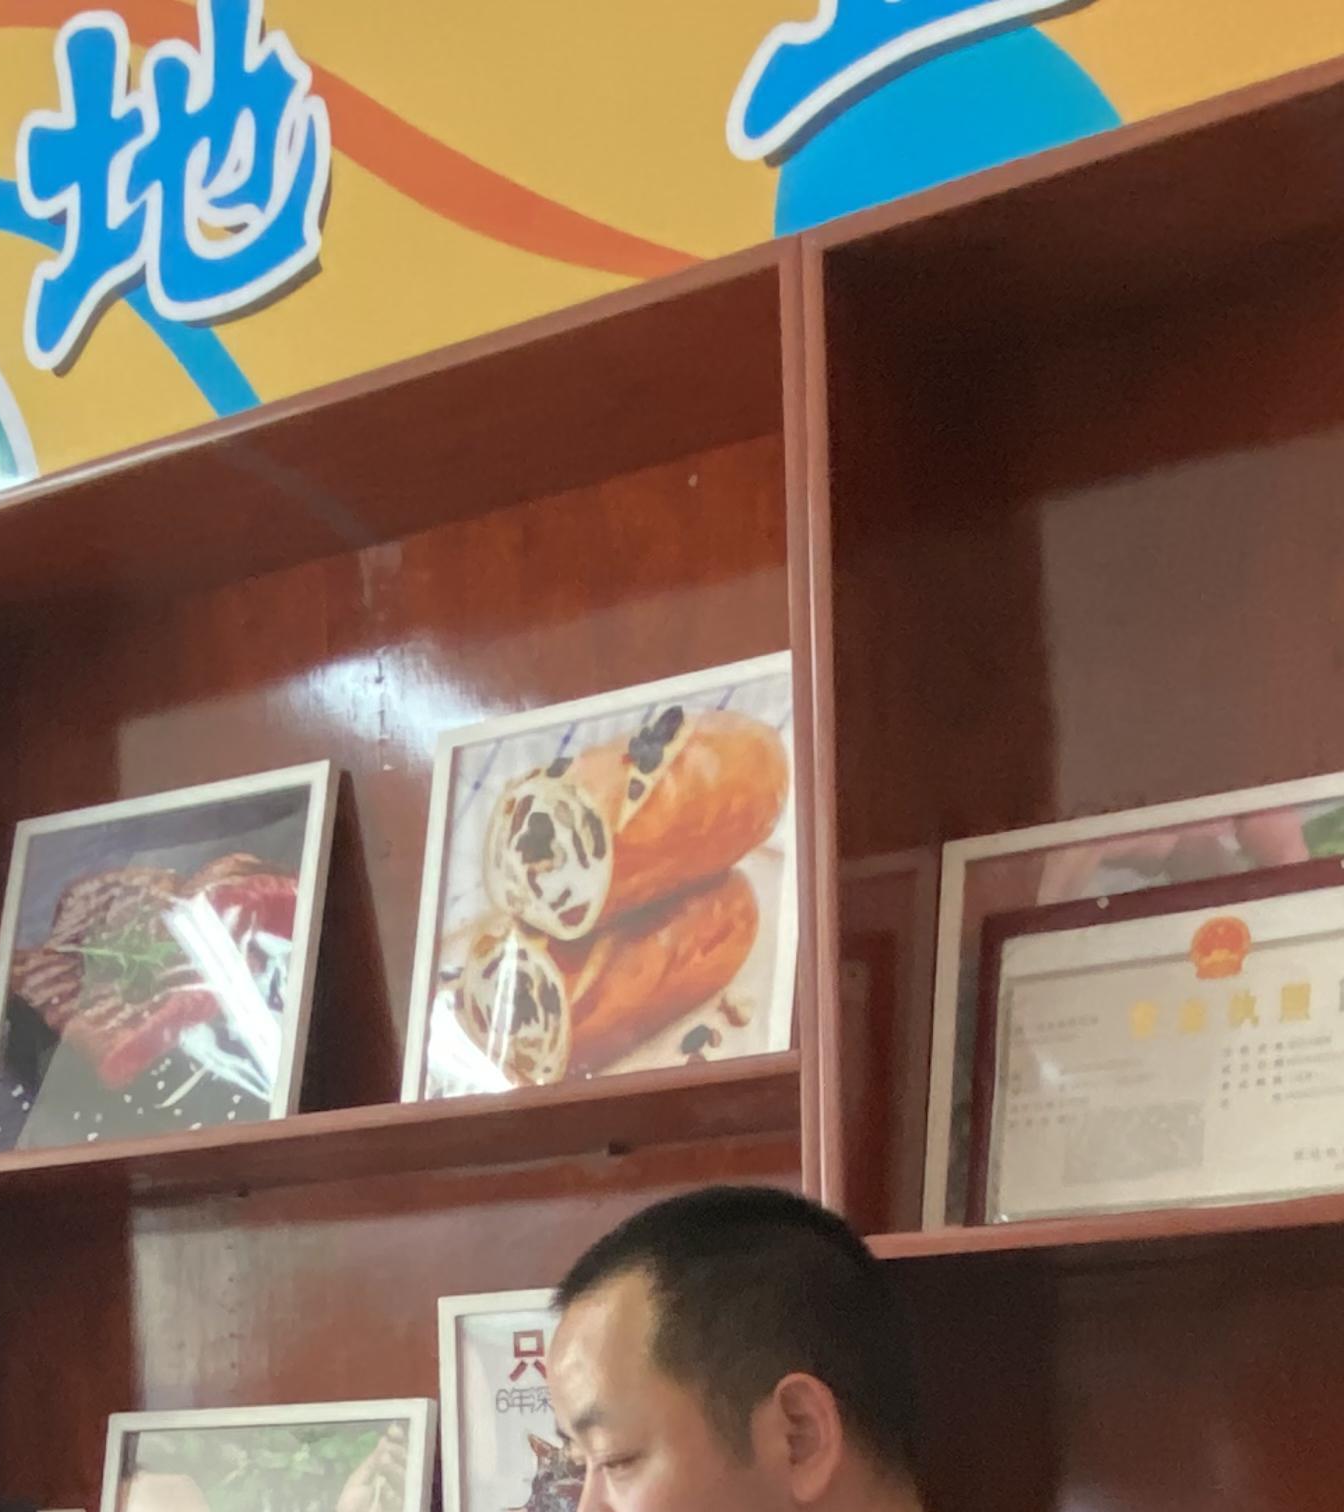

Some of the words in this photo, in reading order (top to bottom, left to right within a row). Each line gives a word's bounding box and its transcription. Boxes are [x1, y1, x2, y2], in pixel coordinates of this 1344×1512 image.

[1128, 982, 1312, 1041] 营业执照
[509, 1328, 548, 1382] 只
